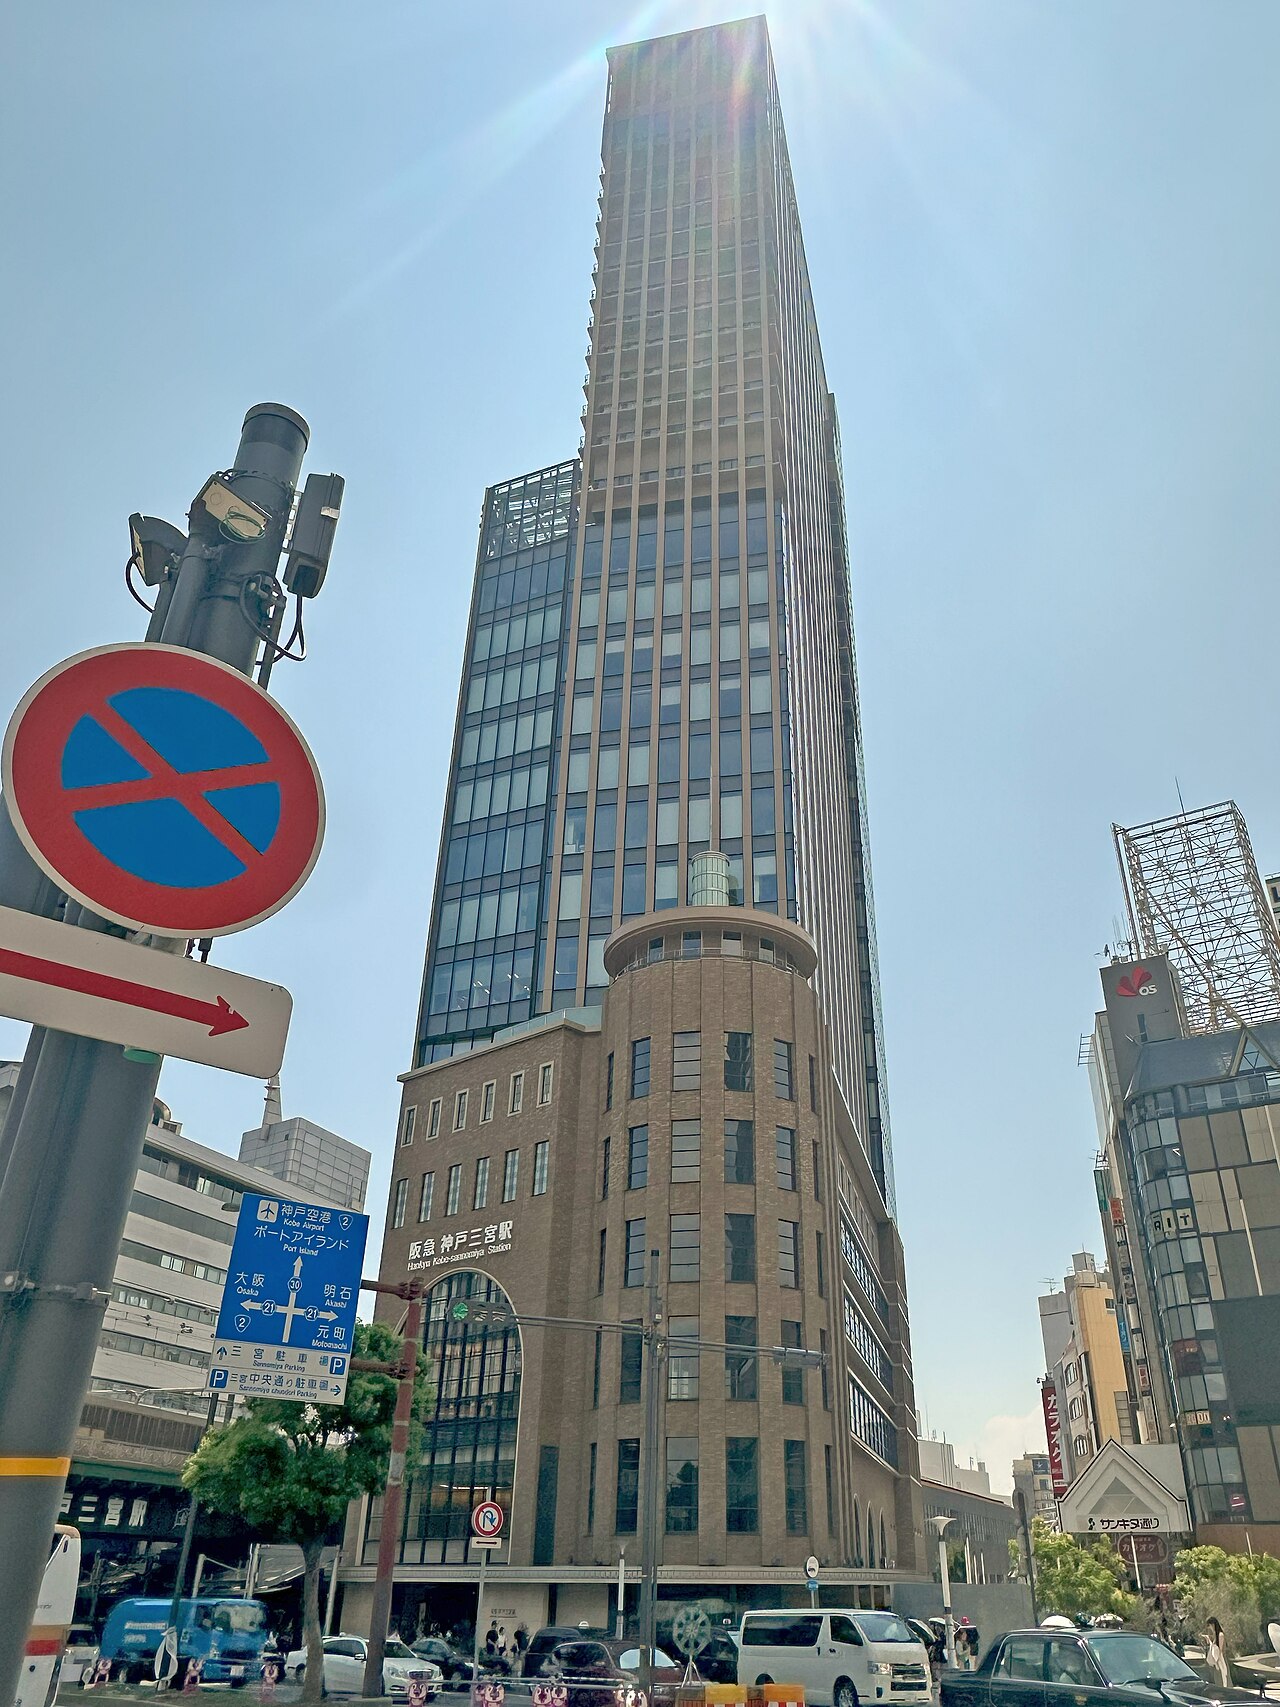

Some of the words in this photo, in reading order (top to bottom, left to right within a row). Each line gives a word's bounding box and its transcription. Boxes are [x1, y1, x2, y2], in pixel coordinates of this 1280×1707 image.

[1139, 984, 1158, 996] OS
[281, 1203, 332, 1224] 神戸空港
[283, 1218, 301, 1228] Kobe
[302, 1222, 325, 1232] Airport
[342, 1216, 349, 1226] 2
[253, 1224, 350, 1251] ポートアイランド
[408, 1238, 436, 1260] 阪急
[440, 1220, 514, 1254] 神戸三宮駅
[283, 1243, 297, 1253] Port
[299, 1246, 319, 1257] Island
[407, 1259, 431, 1272] Hankyu
[487, 1242, 512, 1255] Station
[234, 1271, 266, 1288] 大阪
[289, 1280, 300, 1289] 30
[236, 1286, 259, 1297] Osaka
[323, 1284, 353, 1300] 明石
[263, 1303, 274, 1313] 21
[324, 1299, 348, 1309] Akashi
[307, 1309, 318, 1318] 21
[238, 1318, 245, 1328] 2
[316, 1324, 346, 1340] 元町
[311, 1338, 348, 1350] Motomachi
[230, 1345, 329, 1367] 三宮駐車場
[252, 1359, 283, 1370] Sannomiya
[284, 1363, 306, 1373] Parking
[229, 1373, 329, 1391] 三宮中央通り駐車場
[296, 1389, 318, 1399] Parking
